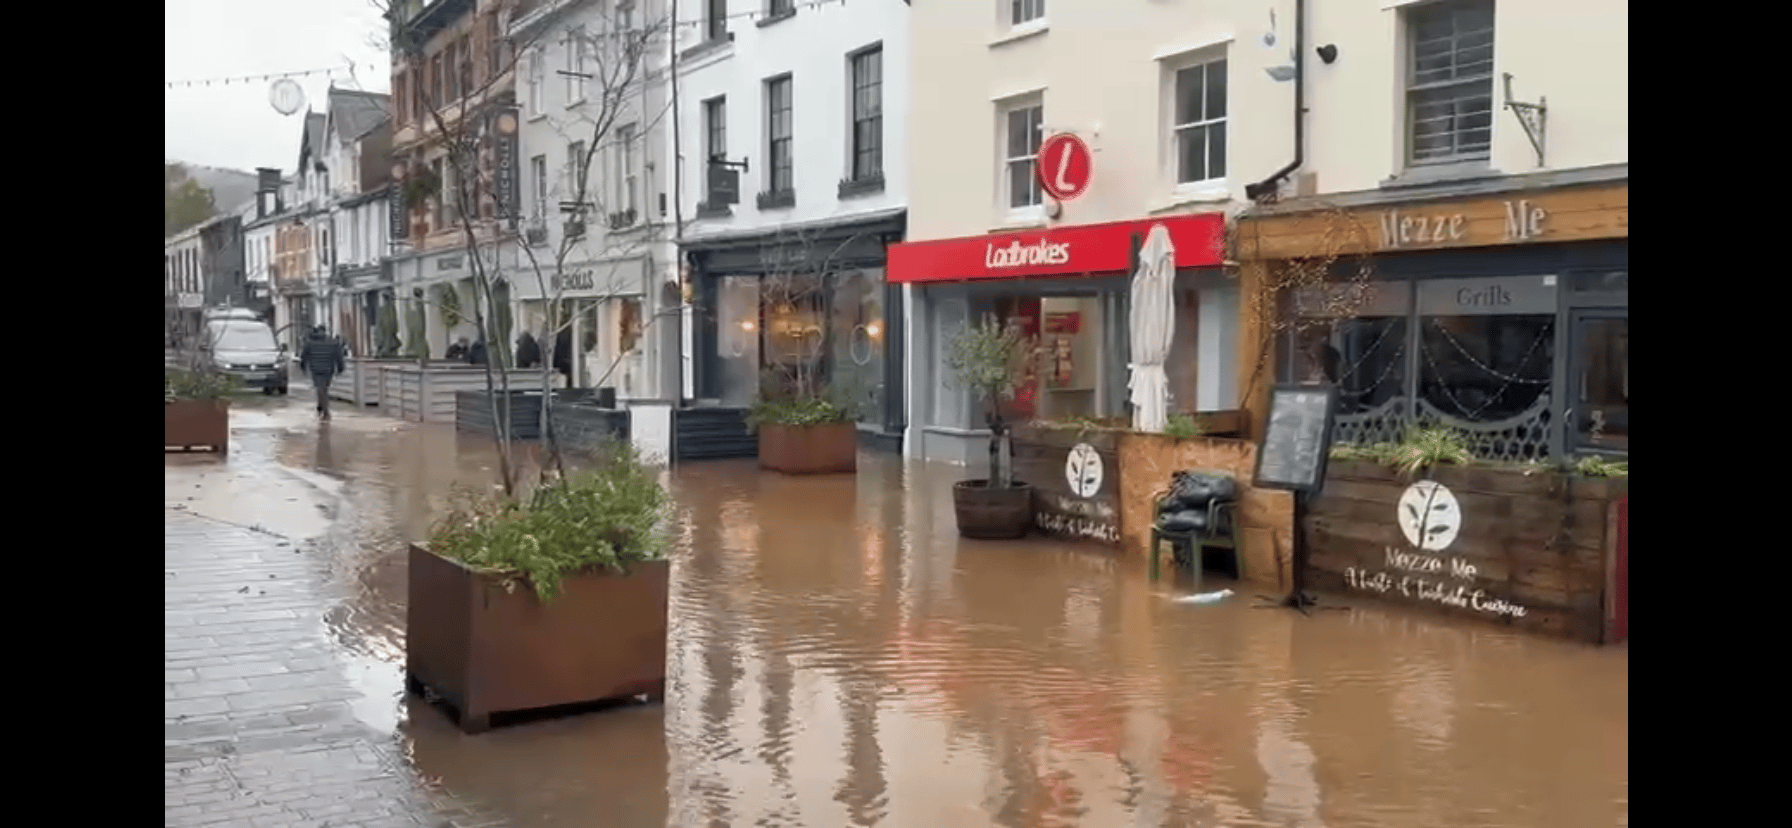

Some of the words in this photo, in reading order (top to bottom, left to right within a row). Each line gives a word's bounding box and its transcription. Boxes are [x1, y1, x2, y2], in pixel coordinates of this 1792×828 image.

[1379, 208, 1465, 249] Mezze
[1502, 199, 1545, 241] Me
[986, 237, 1070, 268] Ladbrokes
[1457, 285, 1511, 306] Grills
[1385, 546, 1442, 573] Mezze
[1451, 556, 1477, 581] Me
